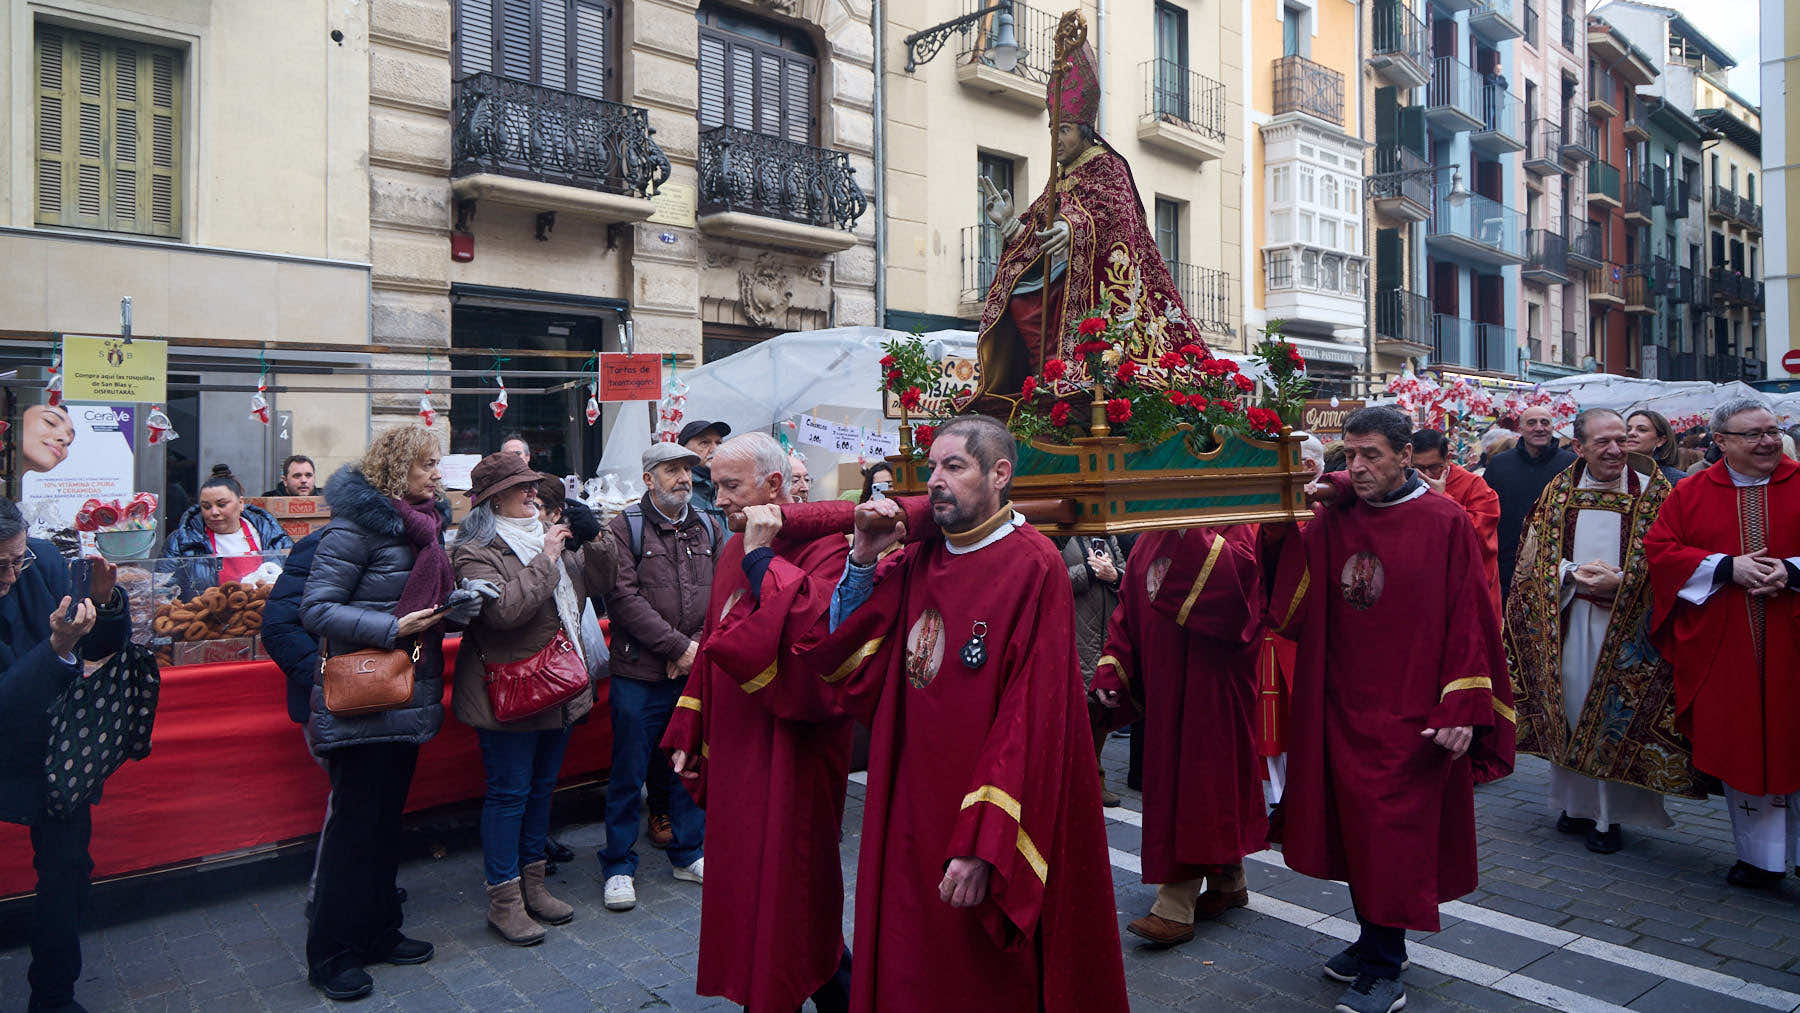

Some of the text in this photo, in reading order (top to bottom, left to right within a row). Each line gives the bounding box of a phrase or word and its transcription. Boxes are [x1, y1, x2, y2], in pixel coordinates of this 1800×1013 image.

[608, 365, 649, 374] Tartas de
[84, 410, 131, 422] CeraVe
